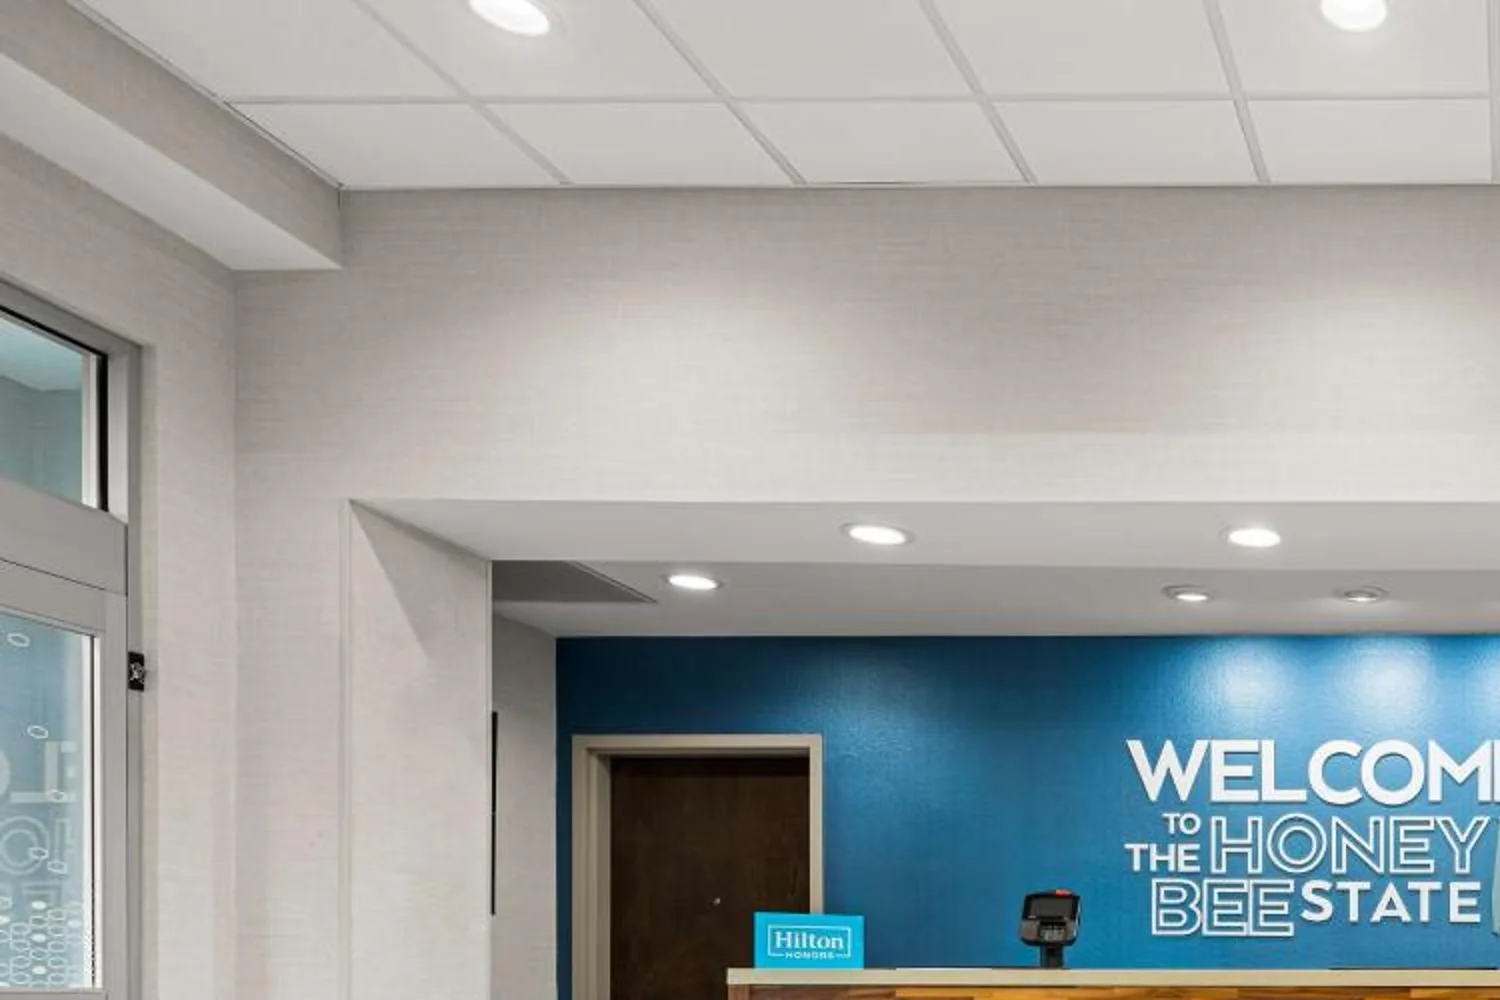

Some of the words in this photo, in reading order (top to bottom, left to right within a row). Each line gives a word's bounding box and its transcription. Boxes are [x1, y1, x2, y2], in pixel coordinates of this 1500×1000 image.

[1162, 812, 1201, 836] TO
[1124, 843, 1200, 873] THE
[1210, 813, 1491, 875] HONEY
[1151, 878, 1295, 937] BEE
[1299, 879, 1482, 923] STATE
[774, 931, 844, 949] Hilton
[785, 951, 834, 959] HONORS
